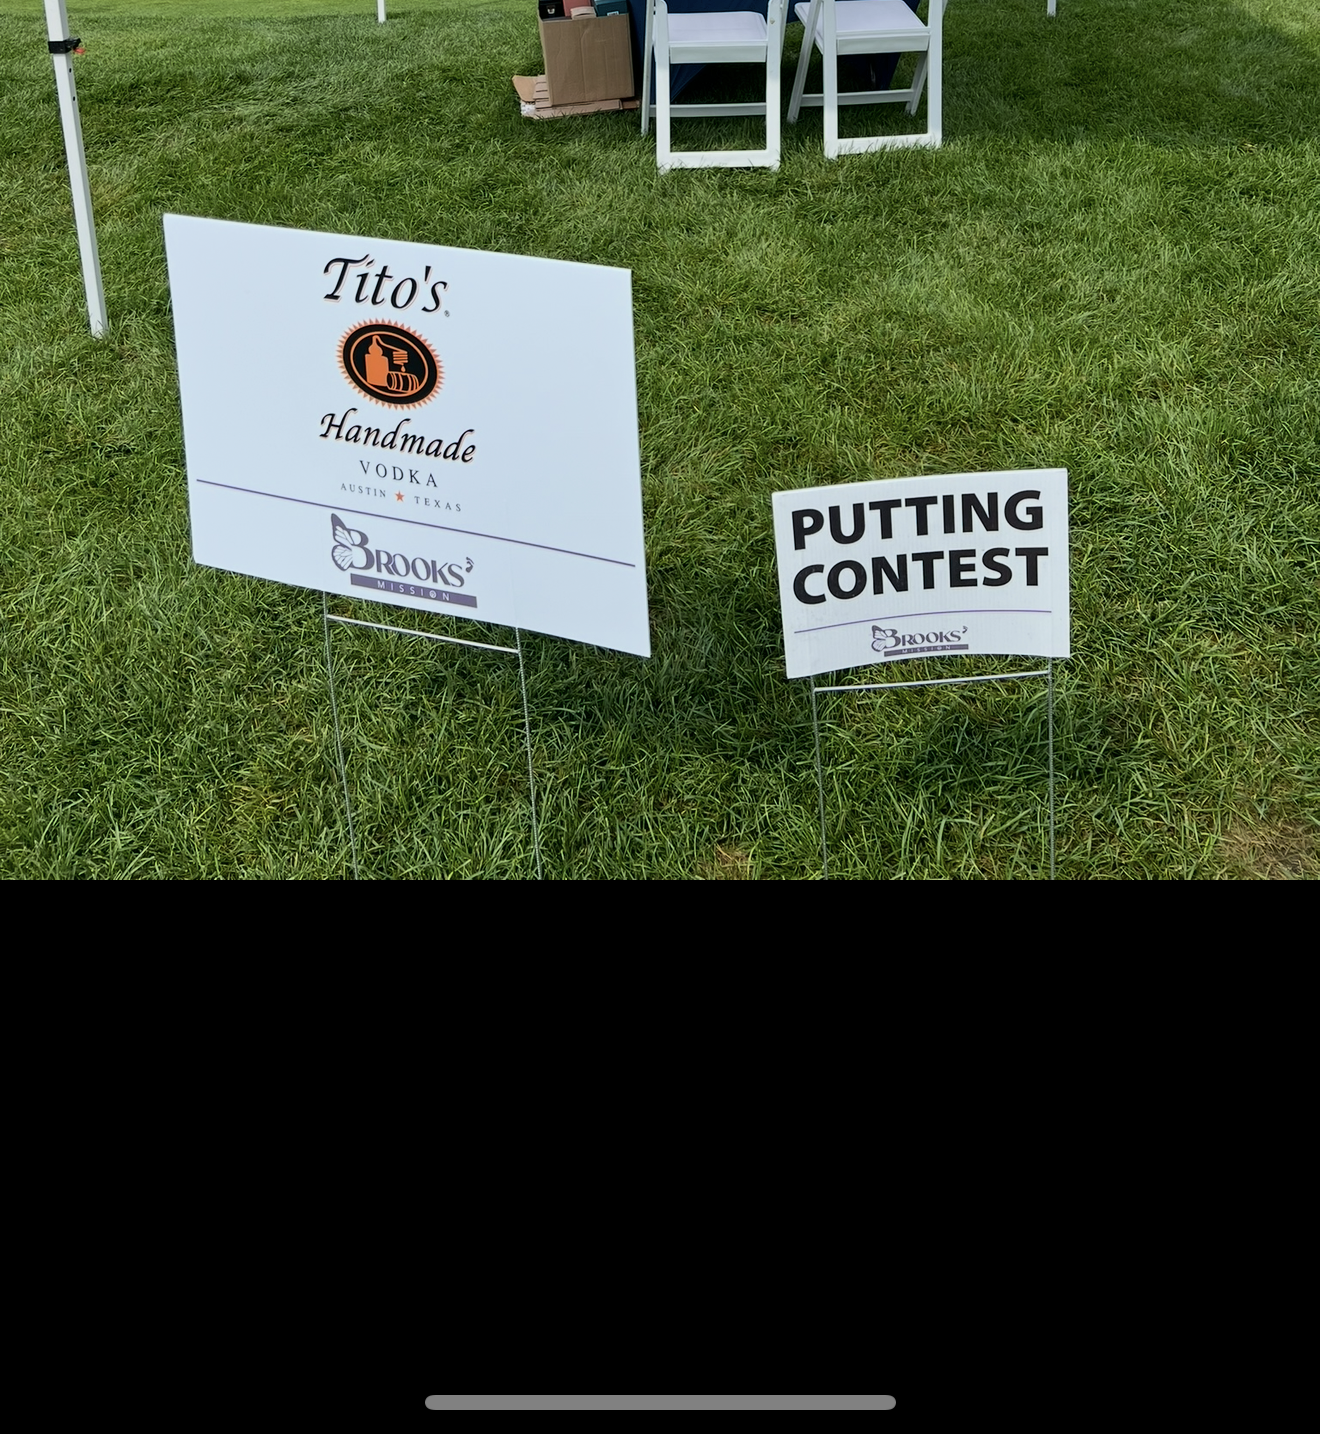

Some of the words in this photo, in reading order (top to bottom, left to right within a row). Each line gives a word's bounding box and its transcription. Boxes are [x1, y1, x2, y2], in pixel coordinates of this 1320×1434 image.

[319, 407, 477, 464] Handmade
[359, 459, 438, 488] VODKA
[340, 482, 387, 498] AUSTIN
[413, 495, 462, 512] TEXAS
[791, 489, 1044, 551] PUTTING
[377, 580, 450, 601] MISSION
[793, 546, 1049, 605] CONTEST
